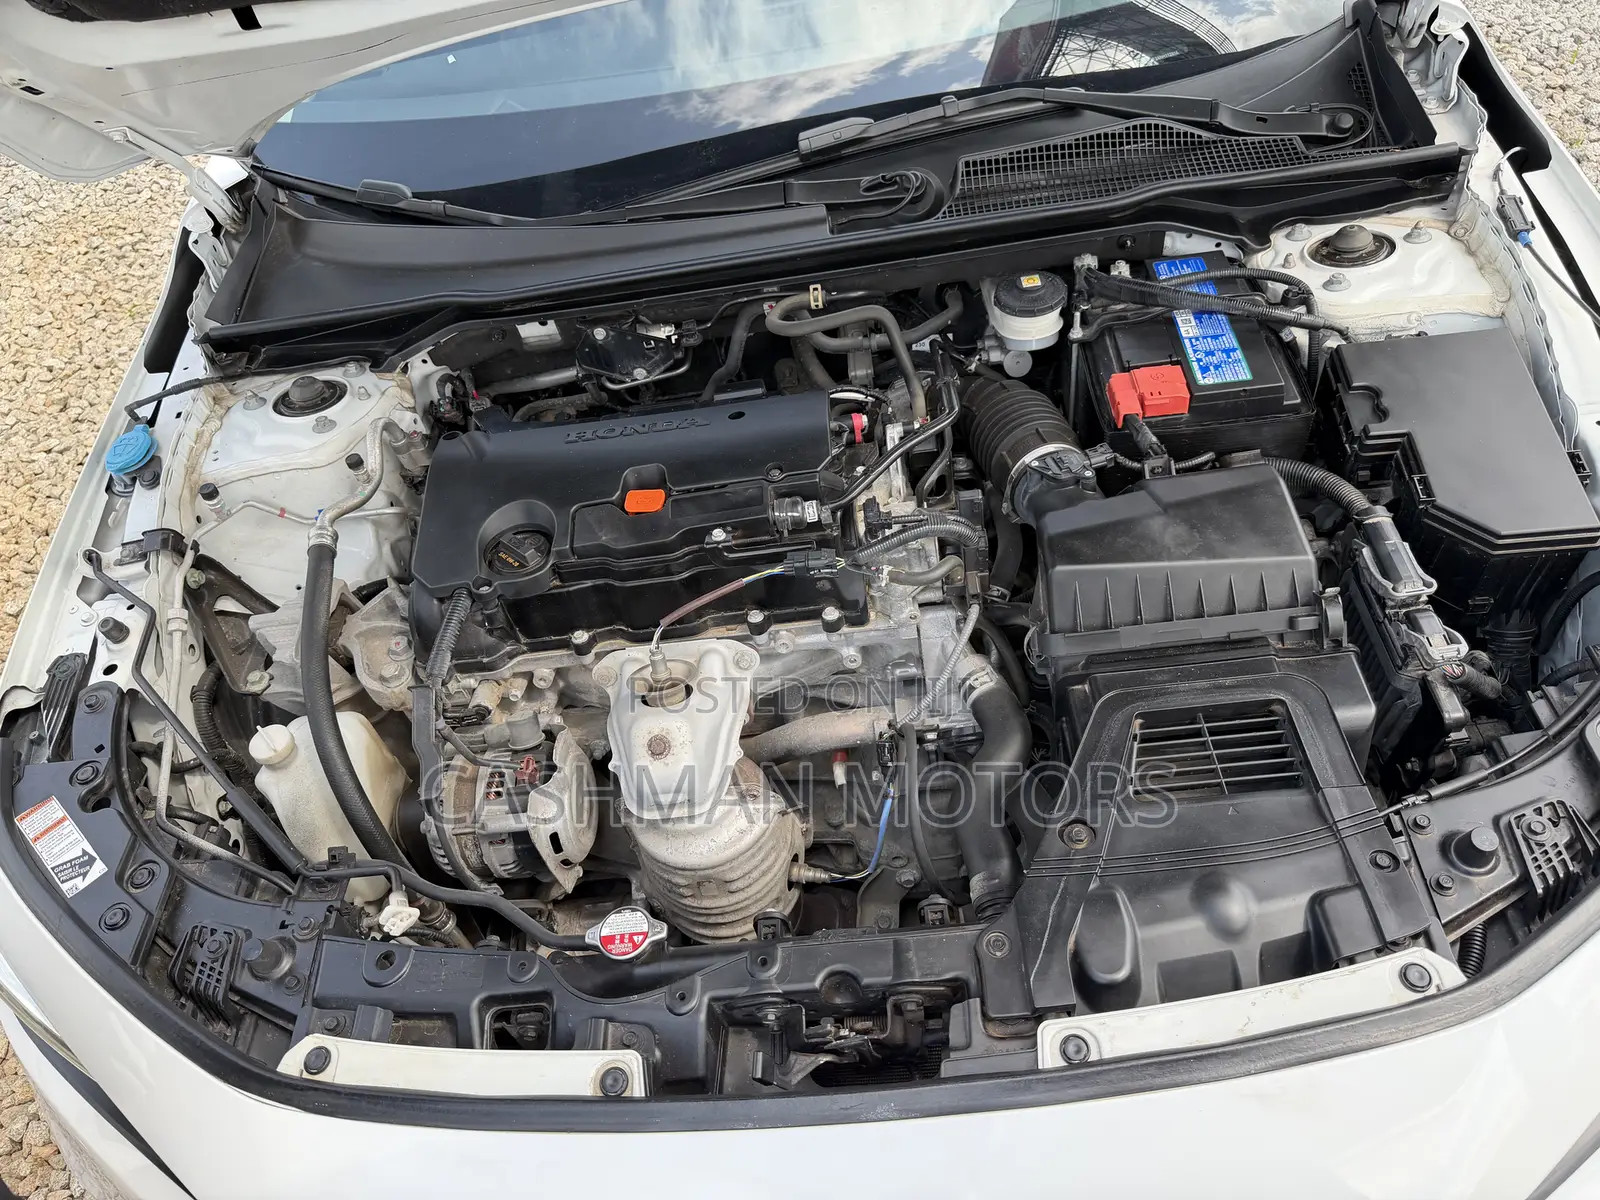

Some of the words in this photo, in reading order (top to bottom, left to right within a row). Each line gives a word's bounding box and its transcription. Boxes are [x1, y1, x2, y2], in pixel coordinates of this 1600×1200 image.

[564, 417, 711, 444] HONDA
[53, 862, 71, 873] GRAB
[71, 855, 89, 866] FOAM
[60, 865, 91, 882] PROTECTEUR
